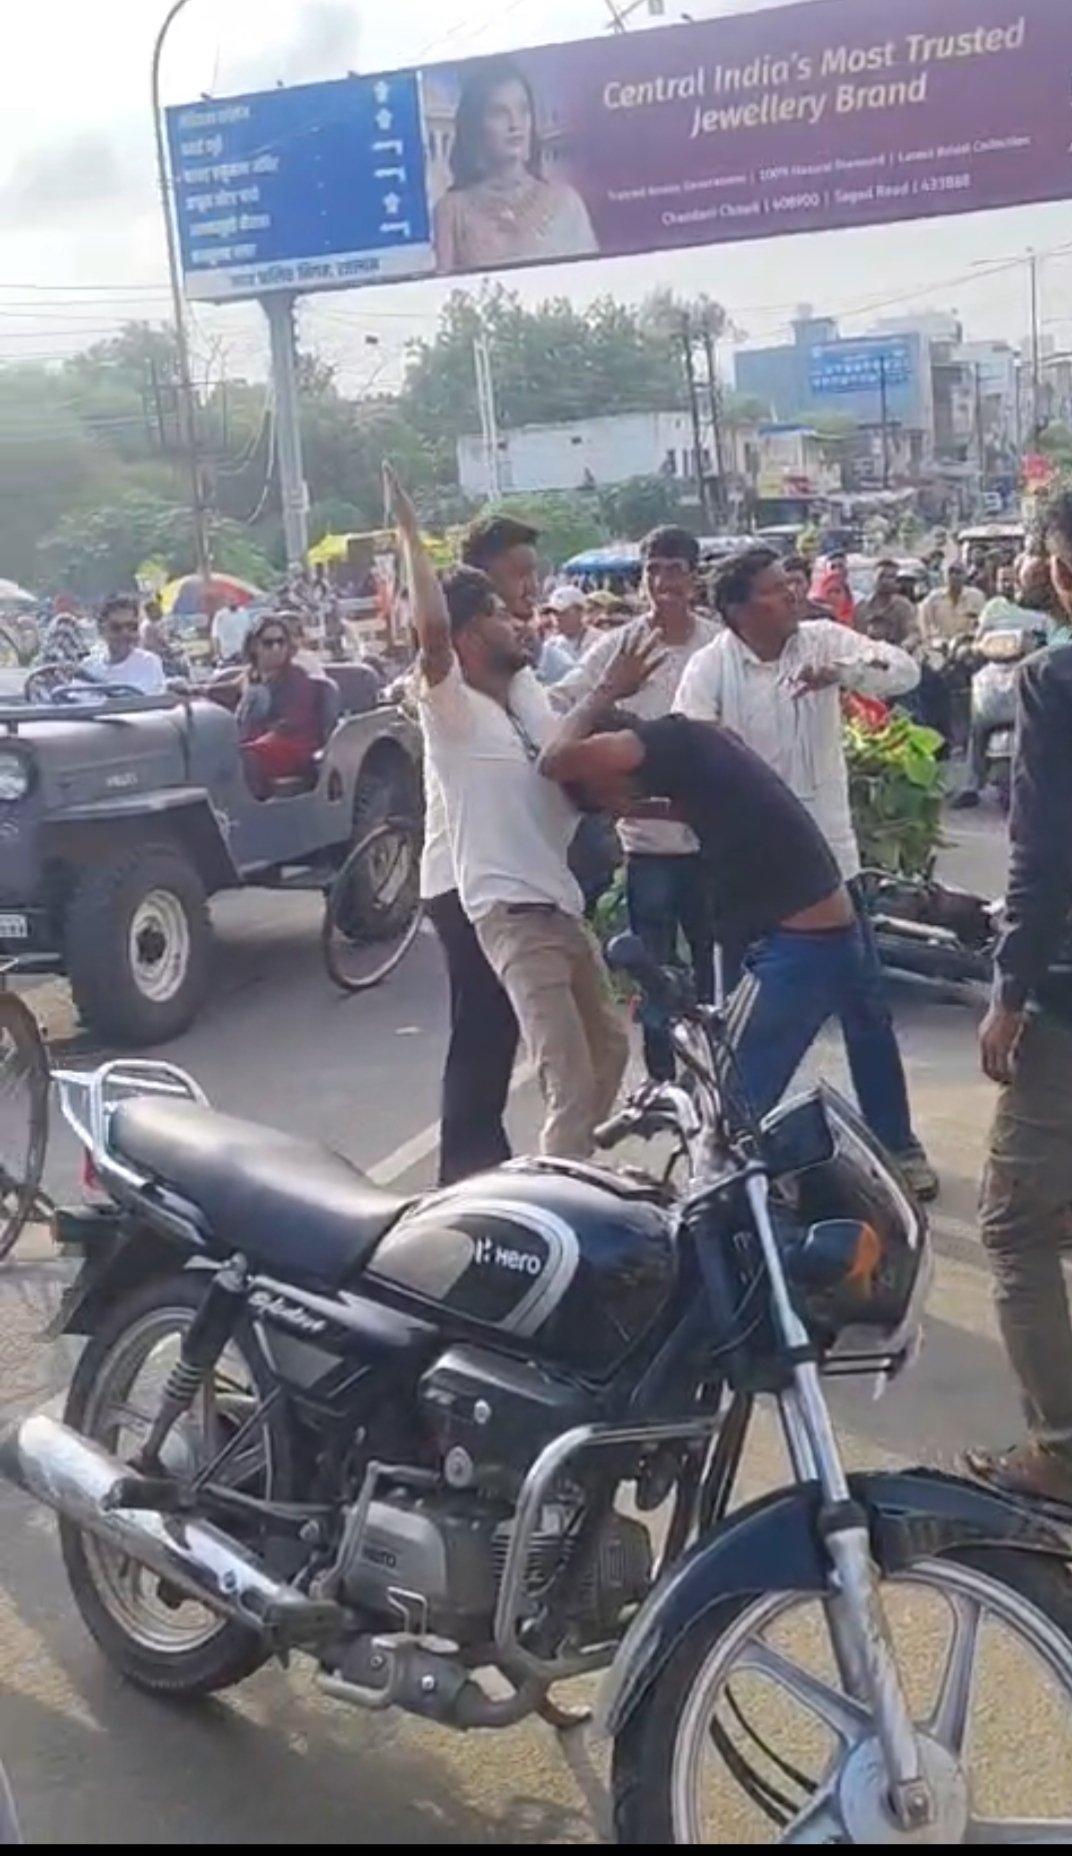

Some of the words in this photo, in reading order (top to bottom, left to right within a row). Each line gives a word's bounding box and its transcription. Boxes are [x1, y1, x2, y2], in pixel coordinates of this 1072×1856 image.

[603, 68, 705, 109] Central
[714, 51, 811, 92] India's
[821, 40, 894, 75] Most
[907, 16, 1025, 62] Trusted
[691, 89, 827, 138] Jewellery
[835, 73, 928, 114] Brand
[876, 181, 909, 199] Road
